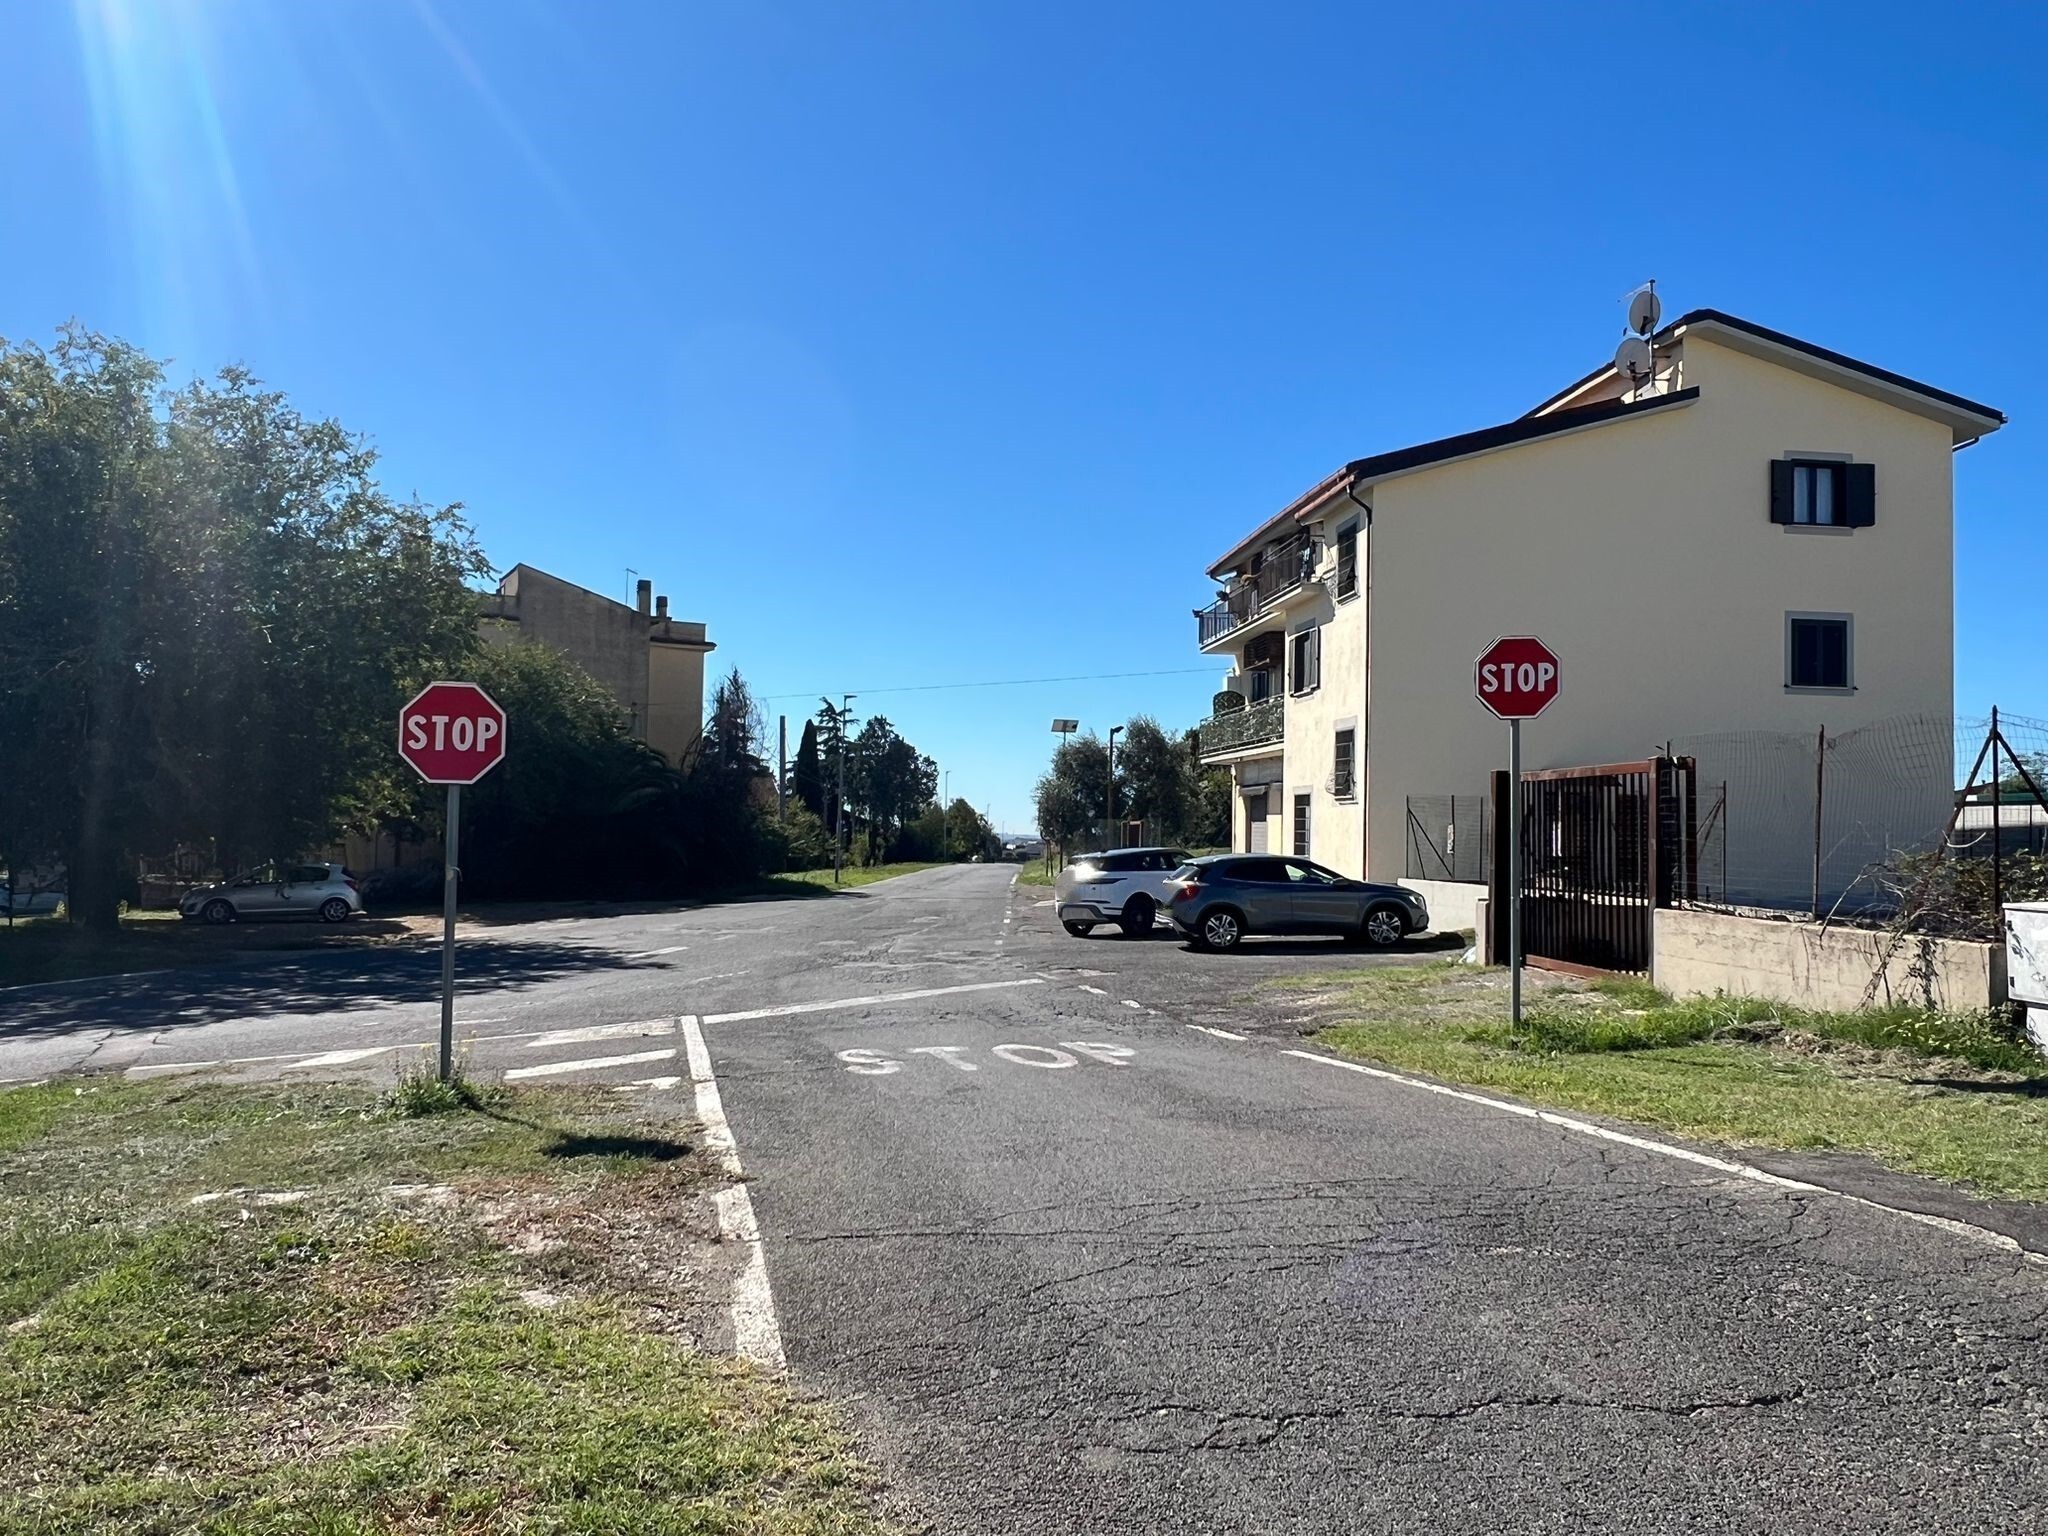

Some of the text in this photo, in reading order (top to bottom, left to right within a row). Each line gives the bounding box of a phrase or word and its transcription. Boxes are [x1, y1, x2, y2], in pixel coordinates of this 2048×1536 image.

[1481, 662, 1555, 693] STOP
[407, 714, 499, 752] STOP
[835, 1041, 1136, 1075] STOP
